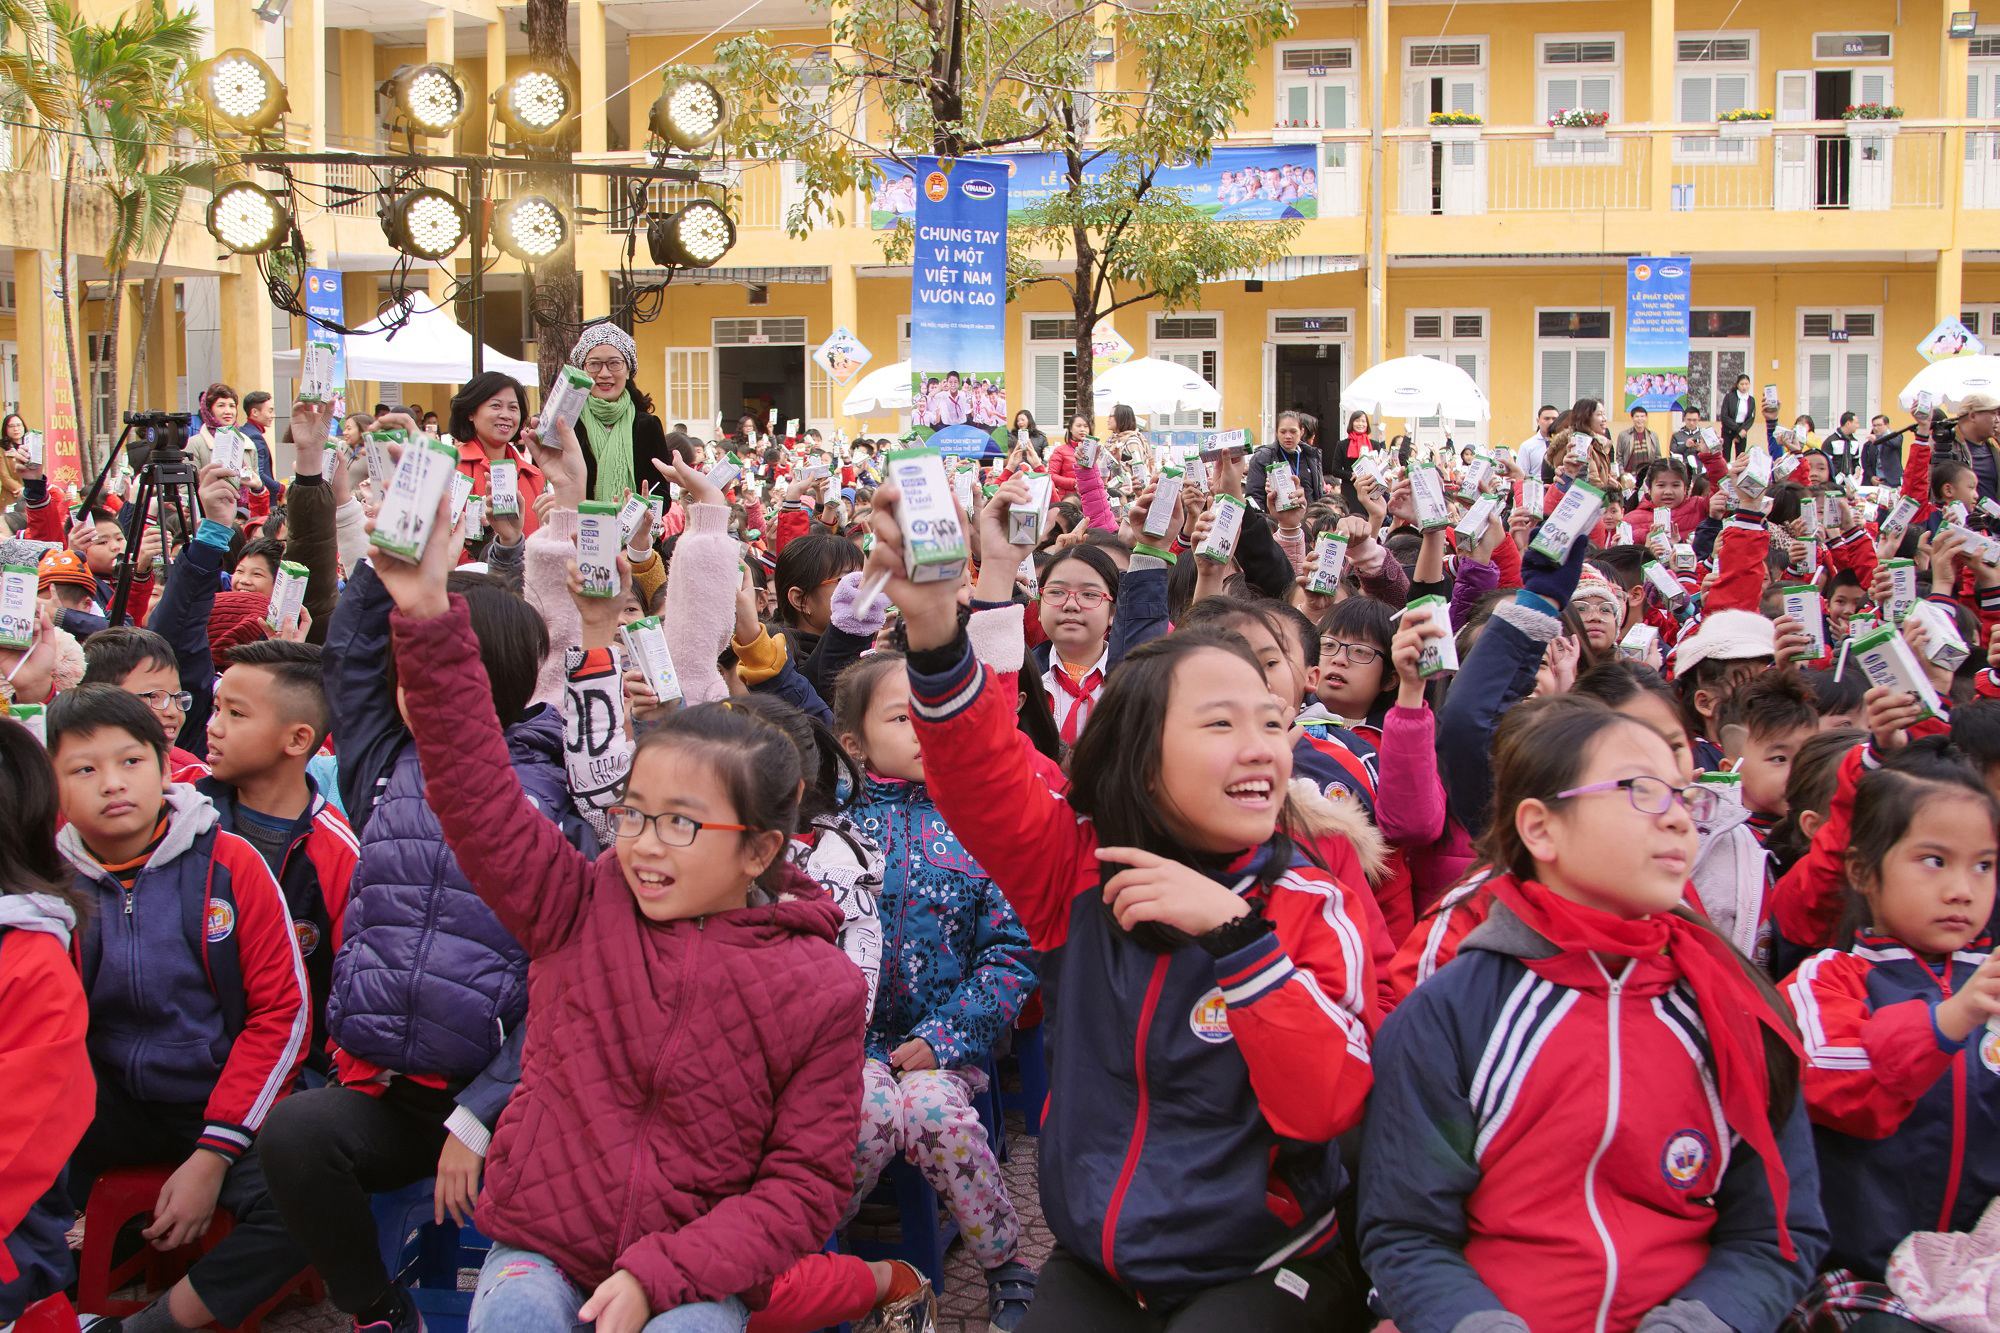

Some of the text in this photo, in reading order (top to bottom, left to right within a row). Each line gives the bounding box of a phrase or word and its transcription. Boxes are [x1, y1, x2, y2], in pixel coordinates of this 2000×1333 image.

[965, 183, 993, 194] VINAMILK
[919, 226, 1000, 245] CHUNG TAY
[934, 245, 985, 267] VÌ MỘT
[924, 266, 992, 287] VIỆT NAM
[919, 288, 996, 306] VƯƠN CAO
[1643, 292, 1661, 301] PHÁT
[1663, 292, 1685, 302] ĐỘNG
[309, 306, 329, 316] CHUNG
[50, 411, 78, 430] DŨNG
[54, 434, 77, 456] CẢM
